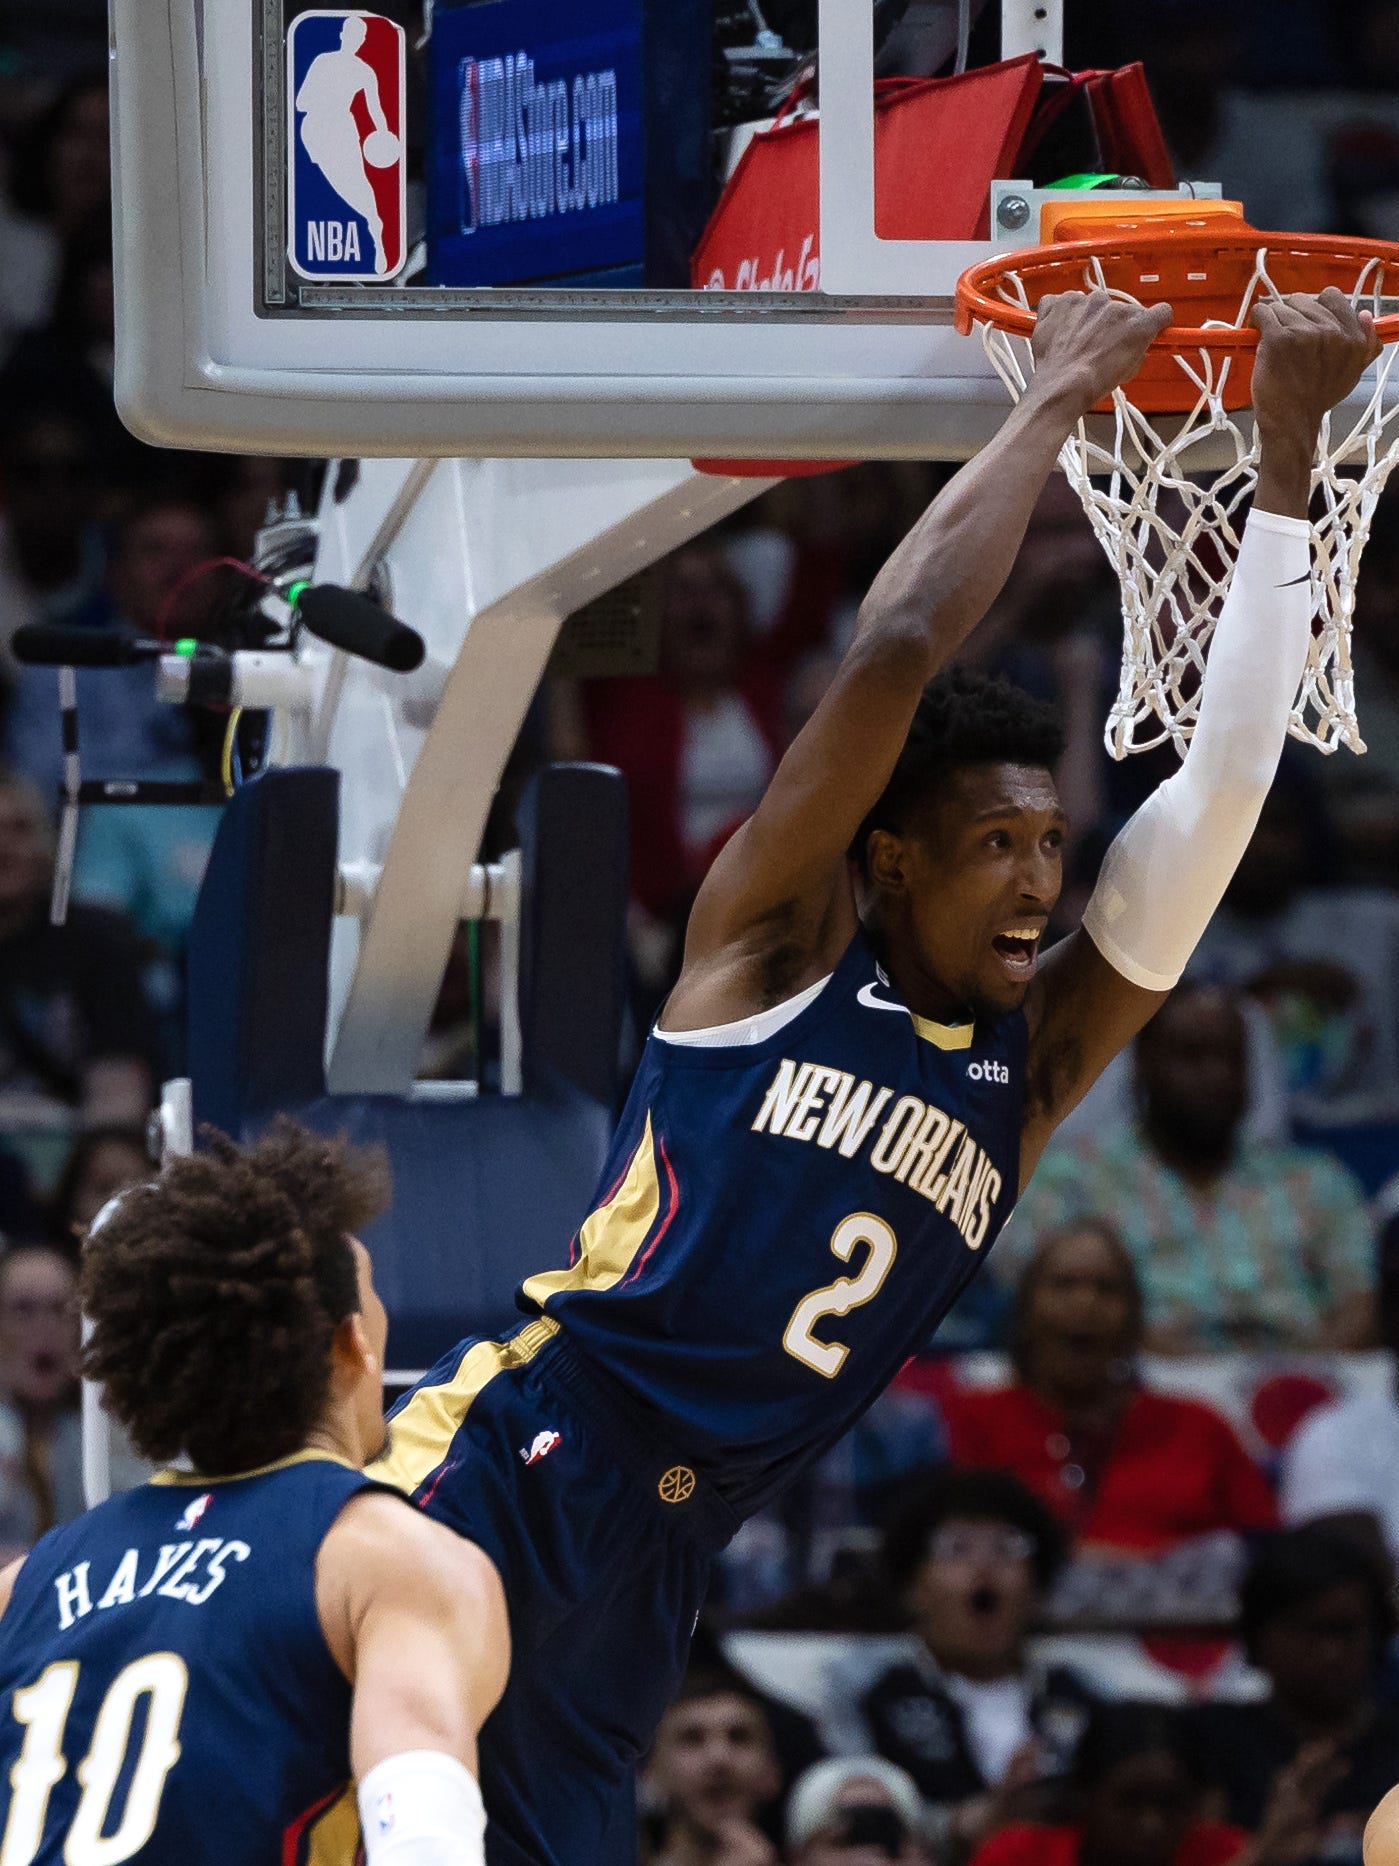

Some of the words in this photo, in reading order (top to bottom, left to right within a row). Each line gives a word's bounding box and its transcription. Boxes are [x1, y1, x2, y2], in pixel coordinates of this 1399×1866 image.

[307, 220, 361, 262] NBA
[751, 1058, 895, 1159] NEW
[782, 1211, 898, 1379] 2
[54, 1537, 251, 1631] HAYES
[0, 1651, 190, 1866] 10
